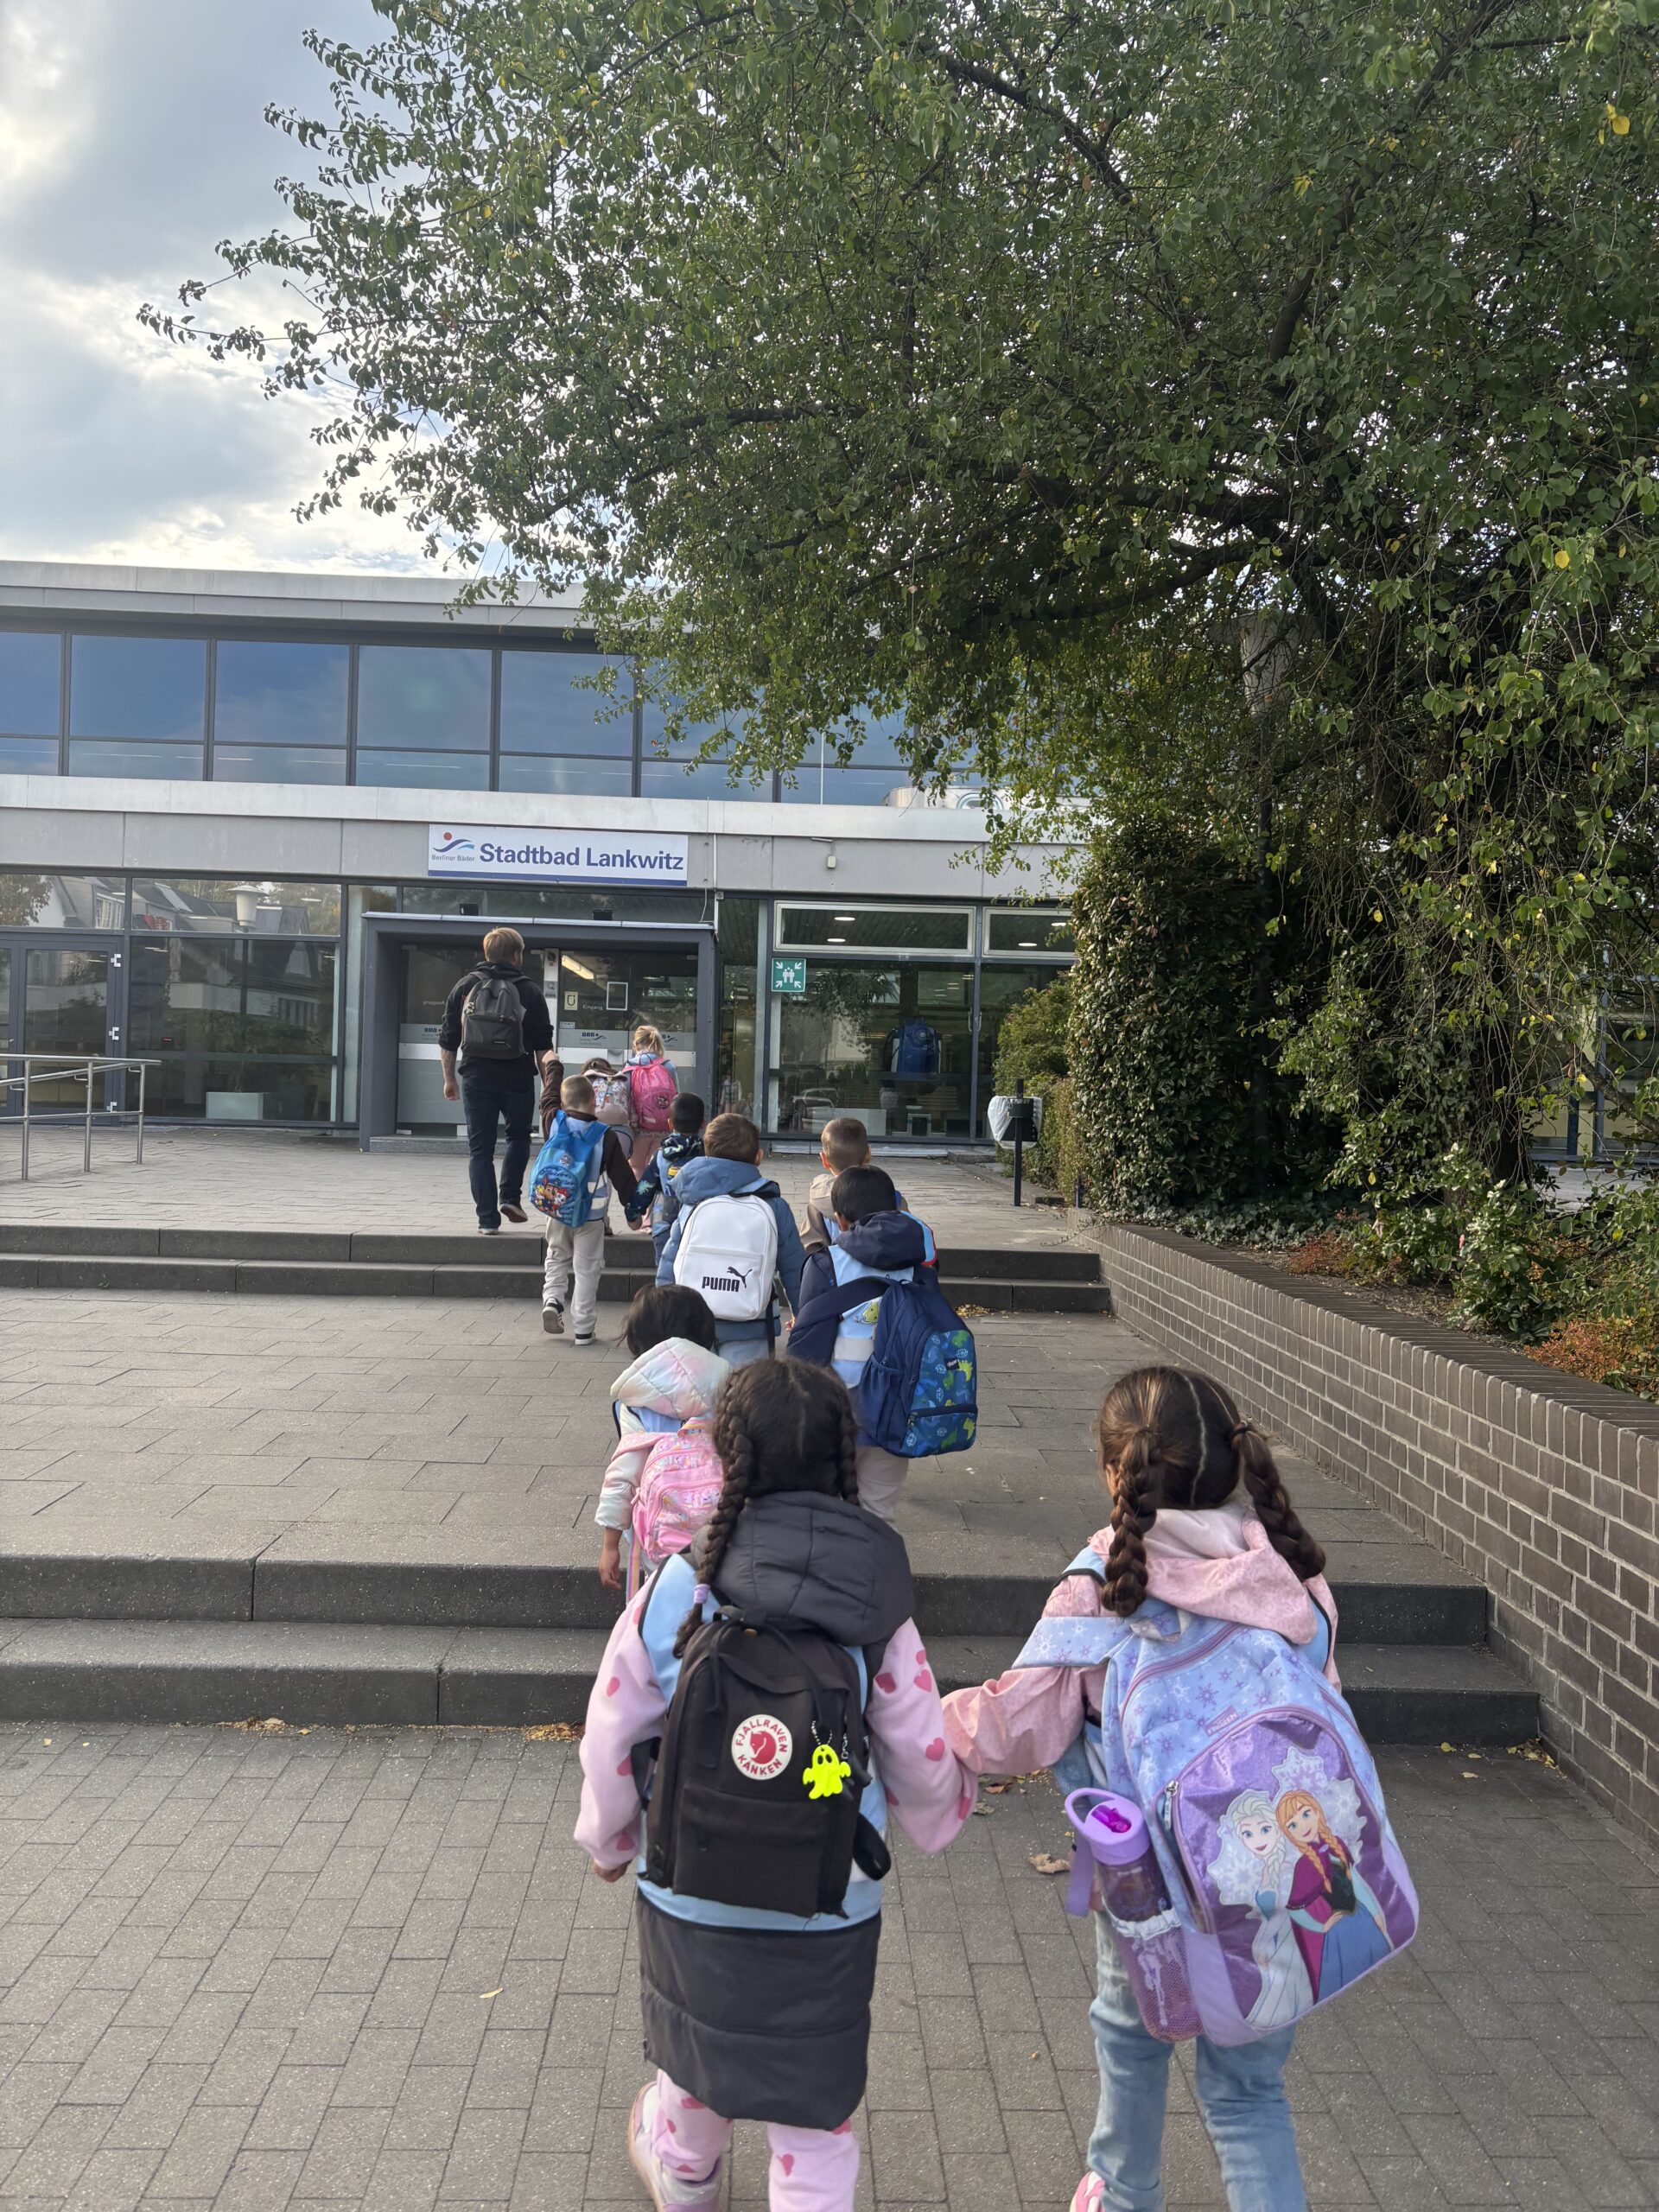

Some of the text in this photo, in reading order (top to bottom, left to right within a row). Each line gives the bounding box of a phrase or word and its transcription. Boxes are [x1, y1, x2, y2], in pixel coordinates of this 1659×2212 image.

[480, 842, 683, 870] Stadtbad Lankwitz
[702, 1276, 740, 1292] PUMA
